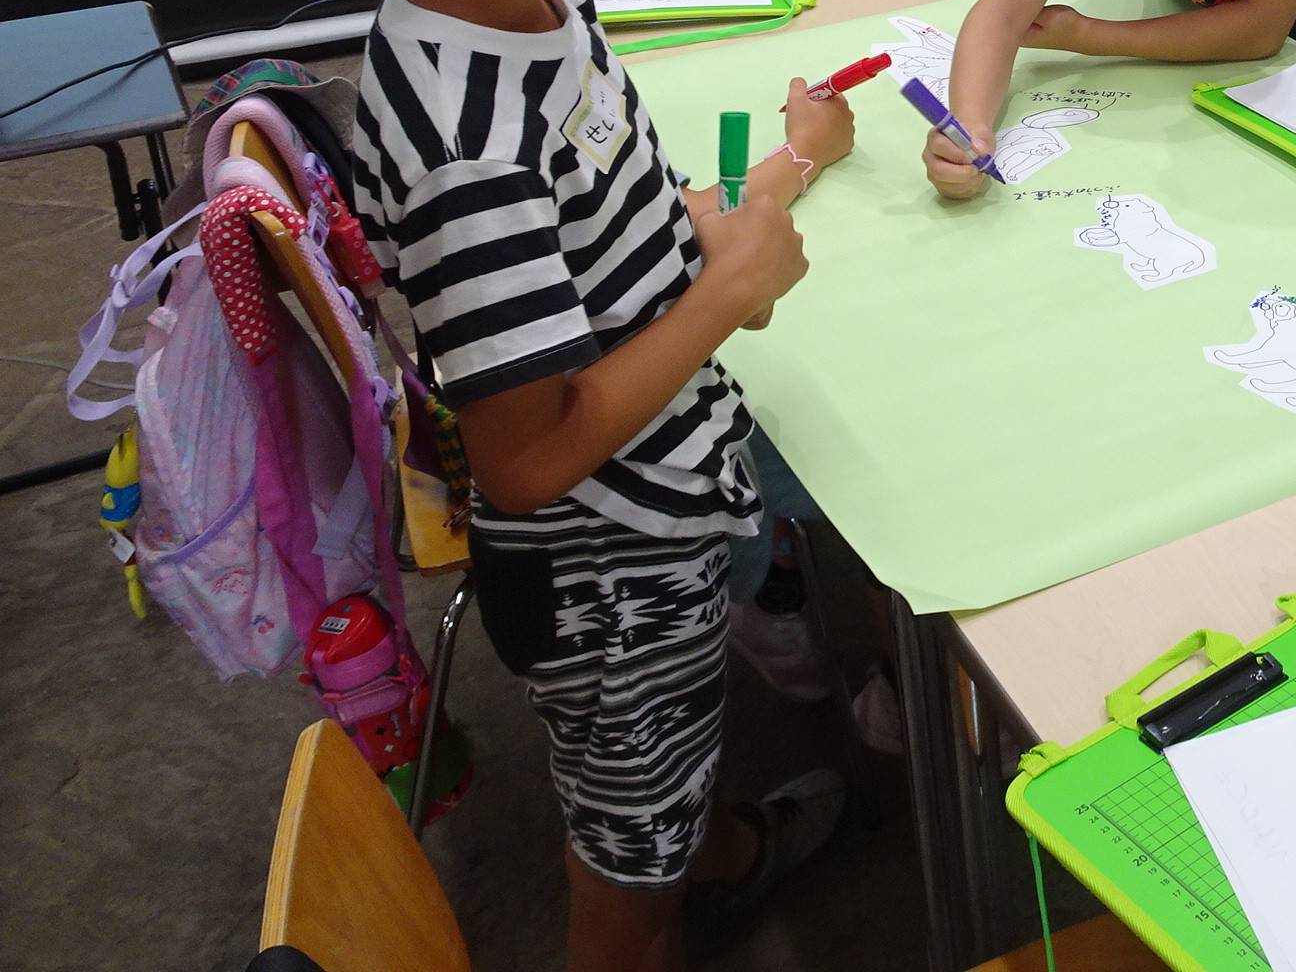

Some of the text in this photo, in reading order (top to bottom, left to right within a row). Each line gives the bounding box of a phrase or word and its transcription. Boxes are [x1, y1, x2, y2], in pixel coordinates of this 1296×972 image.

[1075, 804, 1089, 815] 25
[1089, 816, 1099, 824] 24
[1112, 836, 1122, 844] 22
[1133, 855, 1148, 867] 20
[1148, 867, 1157, 875] 19
[1160, 878, 1170, 887] 18
[1172, 889, 1182, 898] 17
[1184, 901, 1195, 910] 16
[1195, 910, 1209, 922] 15
[1211, 924, 1221, 932] 14
[1223, 937, 1234, 945] 13
[1237, 949, 1247, 957] 12
